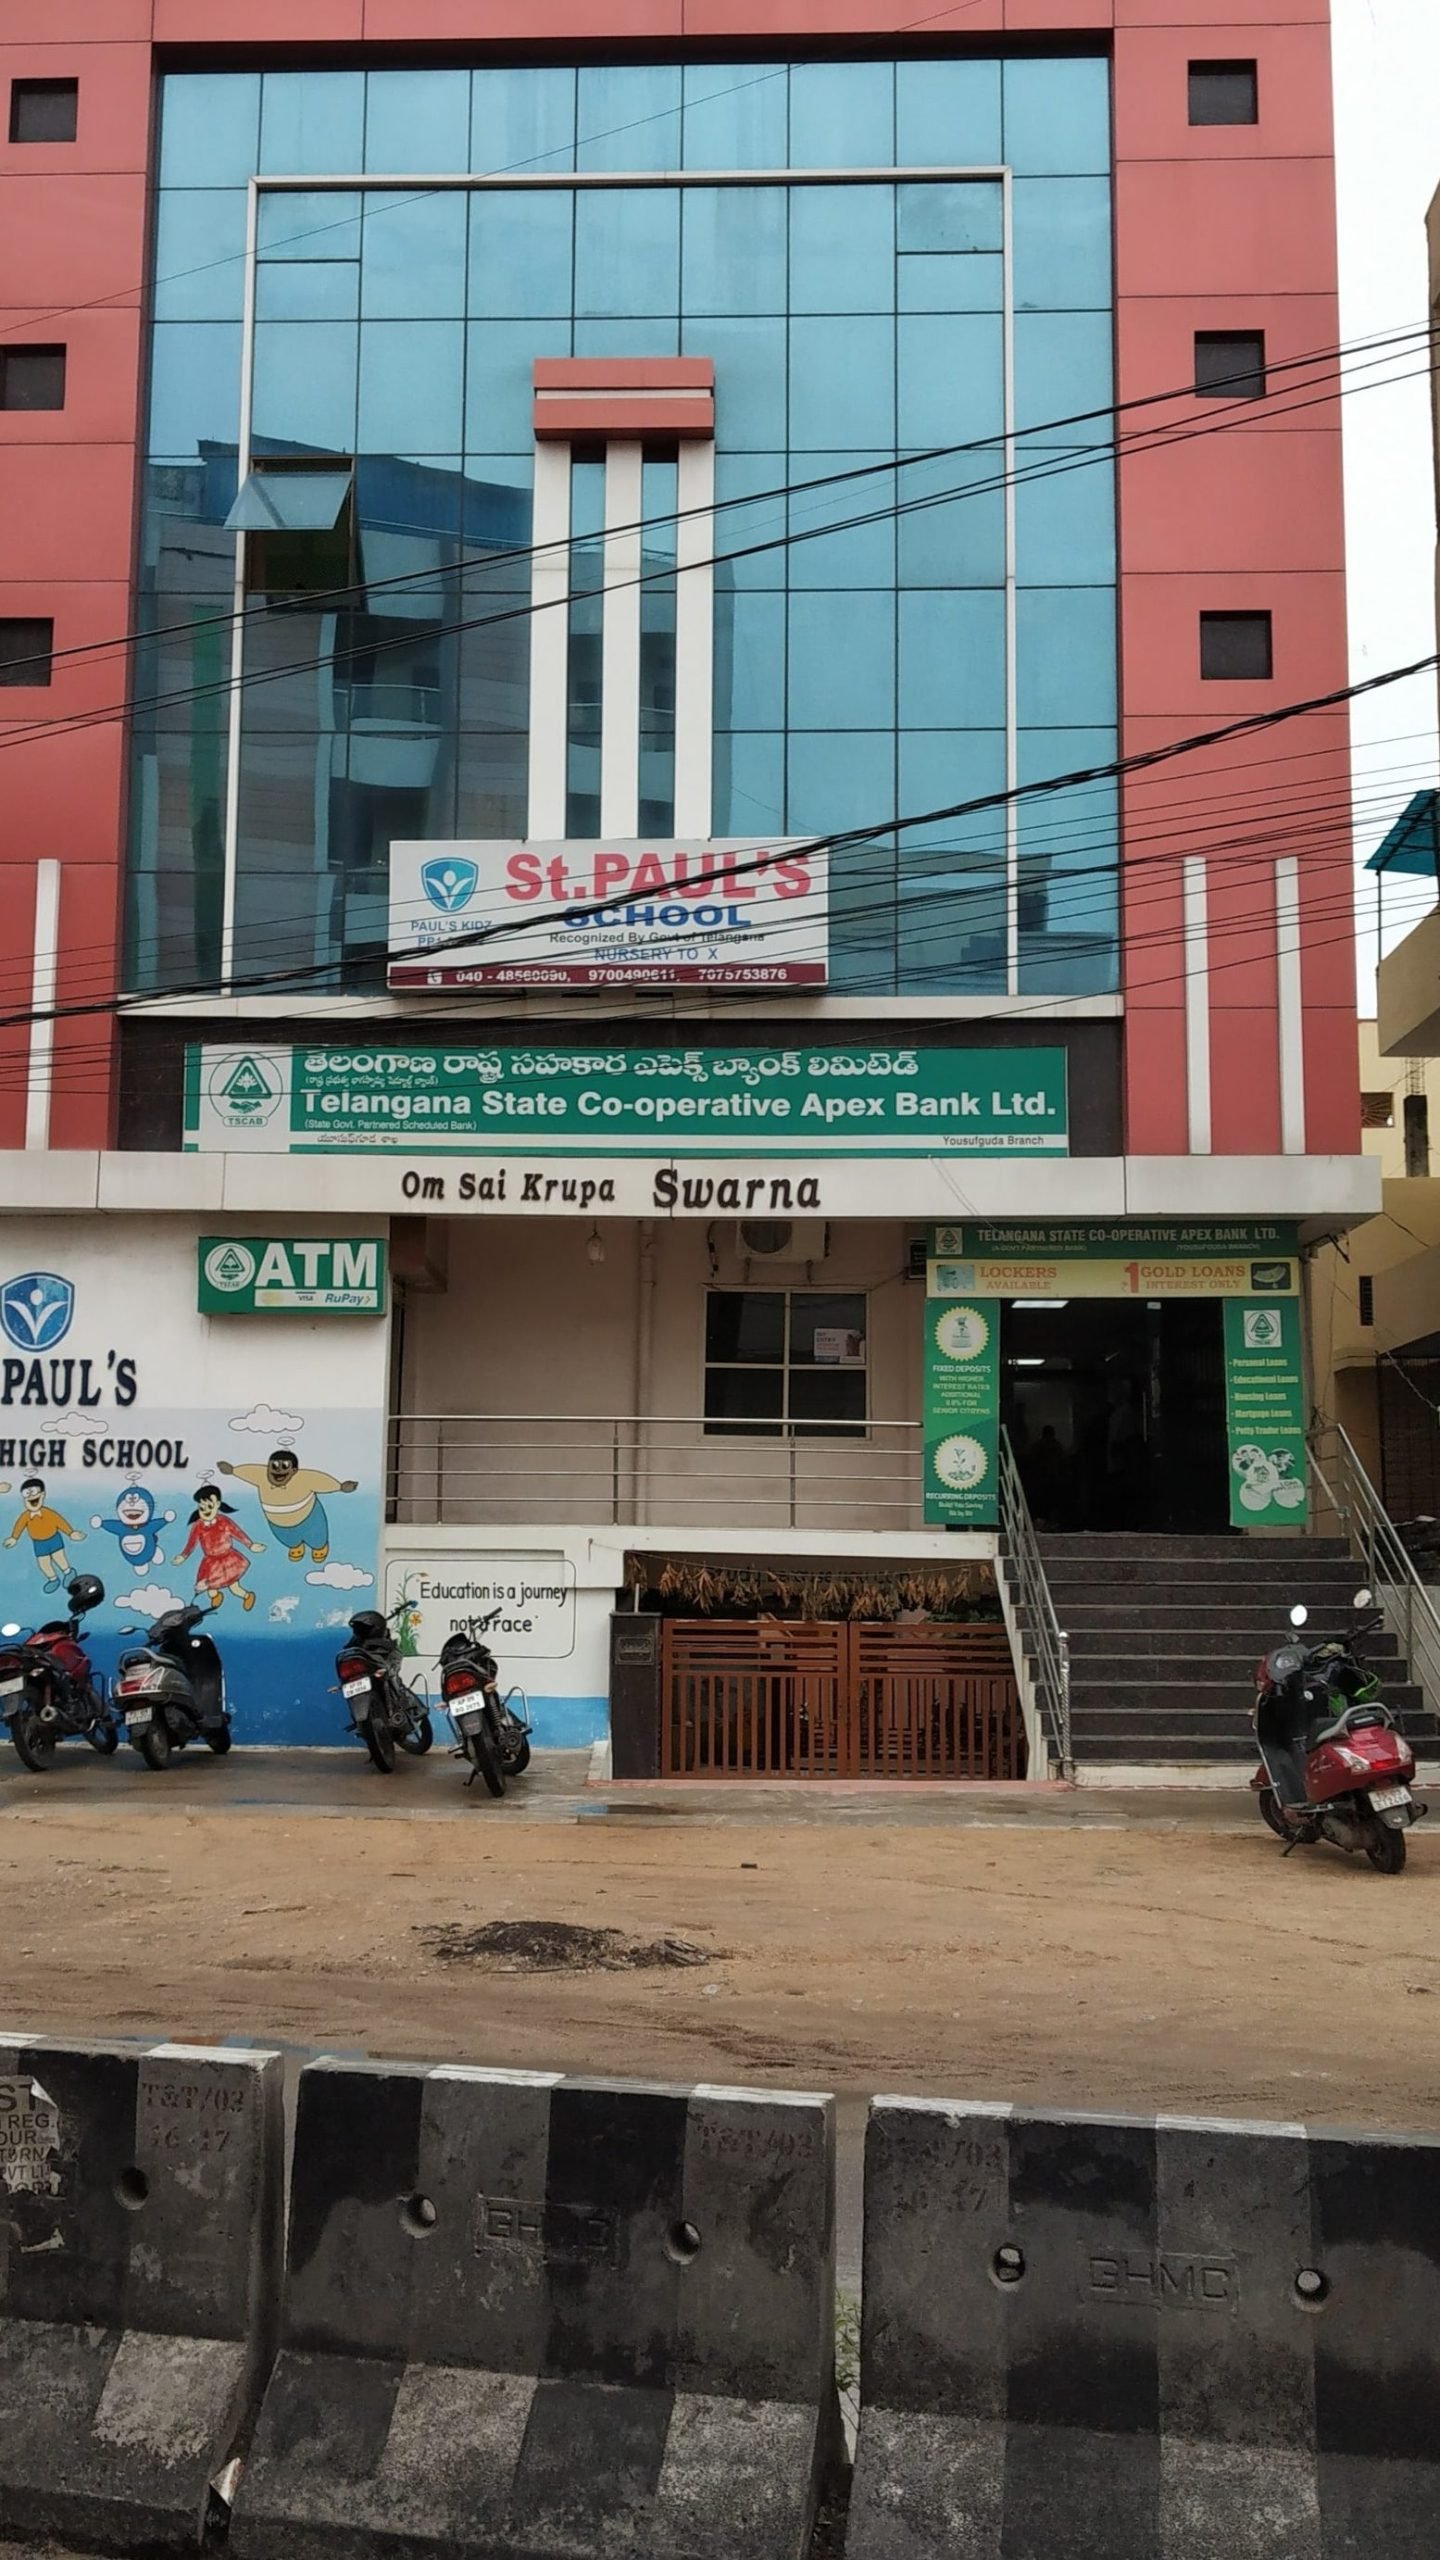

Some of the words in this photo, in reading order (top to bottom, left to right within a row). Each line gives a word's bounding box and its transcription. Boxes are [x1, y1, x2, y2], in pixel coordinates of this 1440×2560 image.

[562, 903, 752, 928] SCHOOL
[411, 919, 457, 932] PAUL'S
[462, 919, 492, 931] KIDZ
[549, 933, 626, 945] Recognized
[628, 932, 644, 945] By
[594, 947, 671, 961] NURSERY
[679, 947, 699, 960] TO
[708, 947, 718, 960] X
[456, 970, 483, 982] 040
[304, 1050, 437, 1074] తెలంగాణ
[443, 1050, 505, 1084] రాష్ట్ర
[511, 1053, 627, 1076] సహకార
[713, 1052, 801, 1085] బ్యాంక్
[807, 1051, 919, 1077] లిమిటెడ్
[301, 1088, 472, 1119] Telangana
[482, 1091, 568, 1116] State
[577, 1091, 791, 1122] Co-operative
[800, 1092, 885, 1123] Apex
[896, 1092, 981, 1116] Bank
[992, 1091, 1056, 1116] Ltd.
[228, 1117, 263, 1127] TSCAB
[304, 1119, 331, 1130] (State
[358, 1120, 401, 1130] Partnered
[403, 1120, 449, 1131] Scheduled
[451, 1120, 477, 1132] Bank)
[943, 1135, 1004, 1148] Yousufguda
[1008, 1136, 1044, 1146] Branch
[402, 1171, 445, 1200] Om
[459, 1169, 507, 1201] Sai
[520, 1173, 616, 1208] Krupa
[653, 1168, 821, 1209] Swarna
[977, 1229, 1046, 1242] TELANGANA
[1049, 1229, 1086, 1242] STATE
[1088, 1228, 1177, 1242] CO-OPERATIVE
[1180, 1229, 1212, 1241] APEX
[1215, 1228, 1248, 1241] BANK
[1254, 1227, 1280, 1240] LTD.
[254, 1242, 377, 1288] ATM
[1140, 1266, 1186, 1278] GOLD
[1192, 1265, 1246, 1278] LOANS
[980, 1266, 1057, 1279] LOCKERS
[986, 1281, 1052, 1290] AVAILABLE
[1146, 1280, 1206, 1290] INTEREST
[1209, 1280, 1241, 1289] ONLY
[325, 1293, 364, 1306] RuPay
[955, 1365, 991, 1374] DEPOSITS
[1, 1349, 138, 1407] PAUL'S
[0, 1439, 67, 1468] HIGH
[82, 1439, 190, 1469] SCHOOL
[420, 1581, 490, 1600] Education
[492, 1582, 505, 1599] is
[506, 1586, 516, 1600] a
[516, 1582, 569, 1608] journey
[493, 1618, 533, 1633] race
[8, 2113, 55, 2129] REG.
